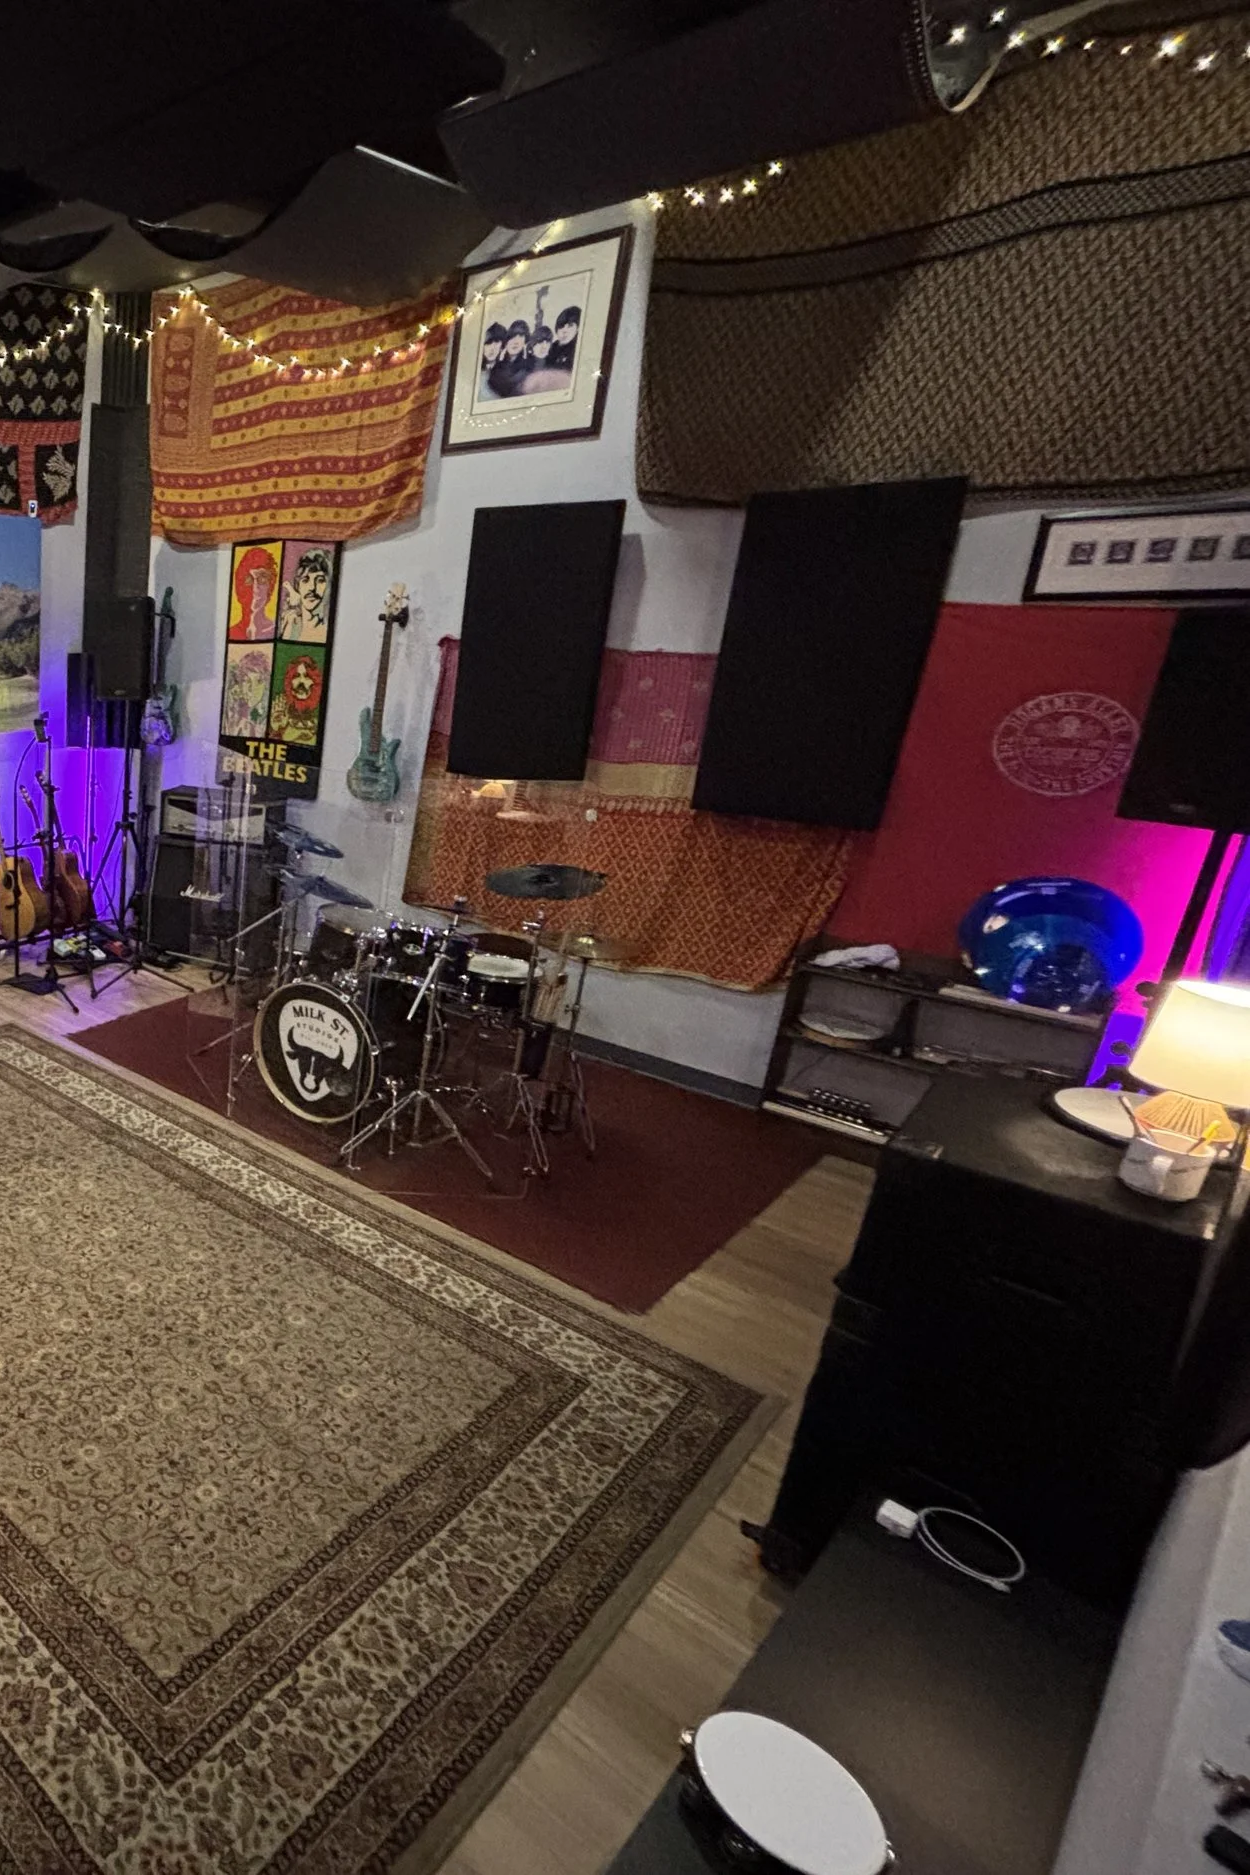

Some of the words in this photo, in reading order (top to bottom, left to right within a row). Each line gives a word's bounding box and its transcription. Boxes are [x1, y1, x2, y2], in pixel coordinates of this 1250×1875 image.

[245, 740, 288, 761] THE
[221, 756, 308, 784] BEATLES
[292, 1005, 326, 1023] MILK
[330, 1018, 350, 1040] ST.
